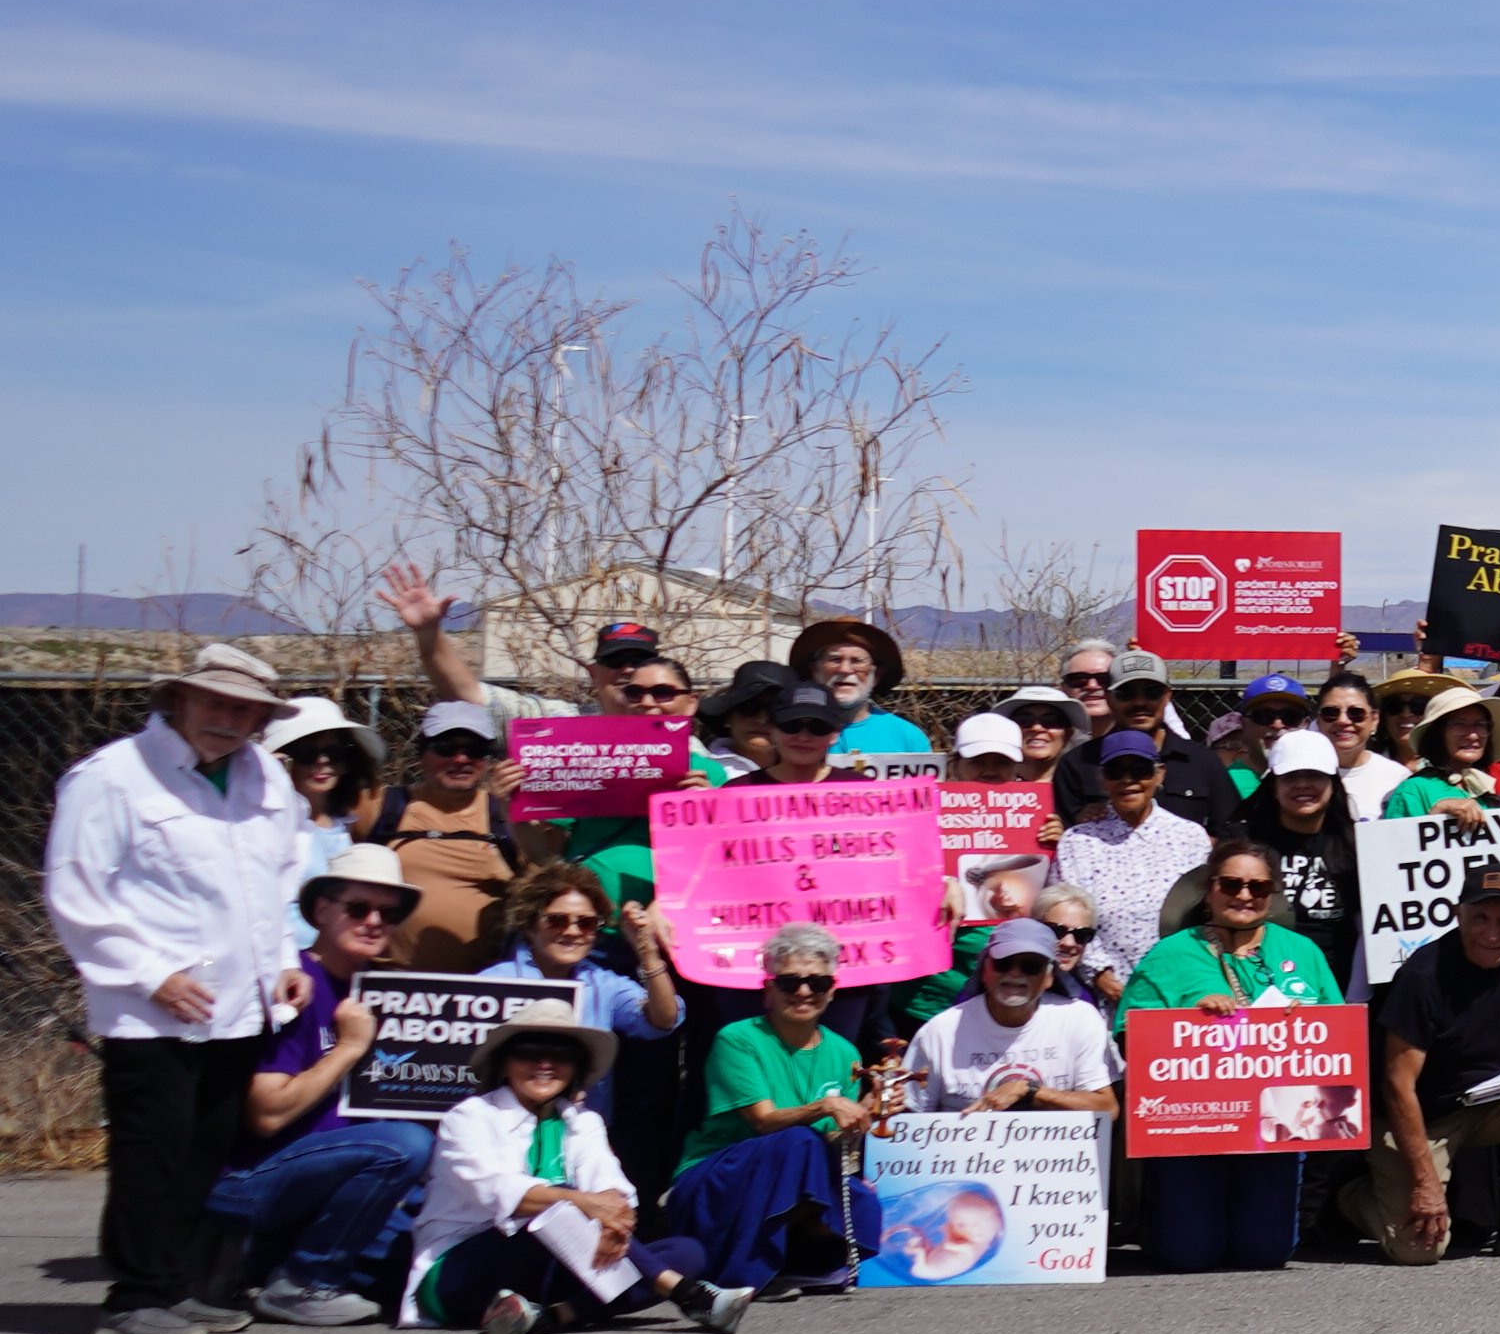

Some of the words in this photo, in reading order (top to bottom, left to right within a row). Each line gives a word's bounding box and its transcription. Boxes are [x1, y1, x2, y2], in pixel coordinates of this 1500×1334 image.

[1158, 576, 1216, 600] STOP
[600, 745, 611, 755] Y
[636, 757, 649, 767] A
[1005, 810, 1034, 827] for
[721, 836, 796, 867] KILLS
[811, 831, 896, 860] BABIES
[796, 865, 817, 891] &
[1399, 859, 1451, 891] TO
[808, 895, 896, 926] WOMEN
[362, 991, 451, 1016] PRAY
[453, 994, 498, 1019] TO
[1173, 1017, 1288, 1052] Praying
[1294, 1016, 1328, 1045] to
[1149, 1053, 1209, 1081] end
[1215, 1049, 1352, 1080] abortion
[985, 1120, 997, 1142] I
[999, 1117, 1101, 1149] formed
[872, 1160, 921, 1183] you
[931, 1154, 956, 1174] in
[966, 1152, 1007, 1174] the
[1014, 1151, 1096, 1176] womb,
[1010, 1185, 1023, 1206] I
[1029, 1184, 1098, 1206] knew
